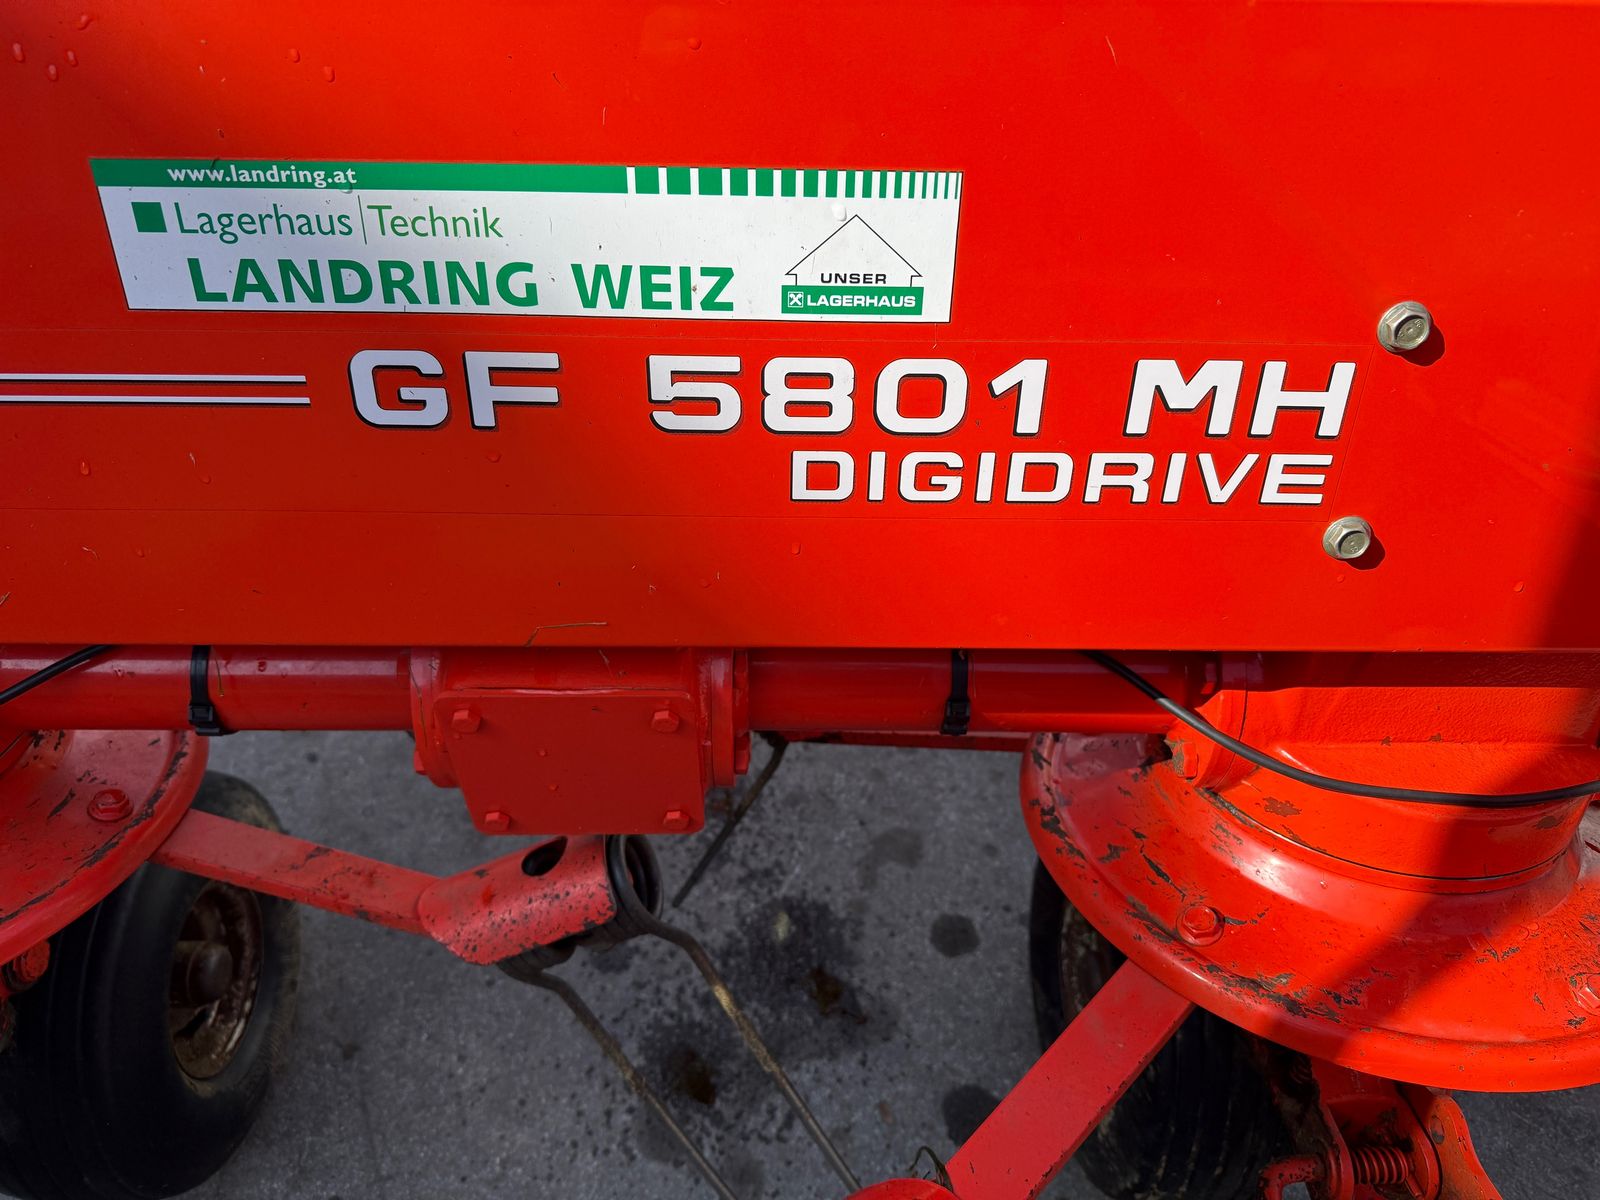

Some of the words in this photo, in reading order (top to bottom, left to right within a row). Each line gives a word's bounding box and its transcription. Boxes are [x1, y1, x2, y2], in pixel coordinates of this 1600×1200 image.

[167, 164, 358, 188] www.landring.at
[173, 201, 353, 244] Lagerhaus
[366, 204, 504, 239] Technik
[187, 257, 539, 308] LANDRING
[570, 263, 735, 312] WEIZ
[820, 272, 887, 285] UNSER
[806, 293, 916, 308] LAGERHAUS
[348, 349, 562, 430] GF
[646, 354, 1049, 437] 5801
[1122, 359, 1357, 439] MH
[790, 450, 1335, 506] DIGIDRIVE
